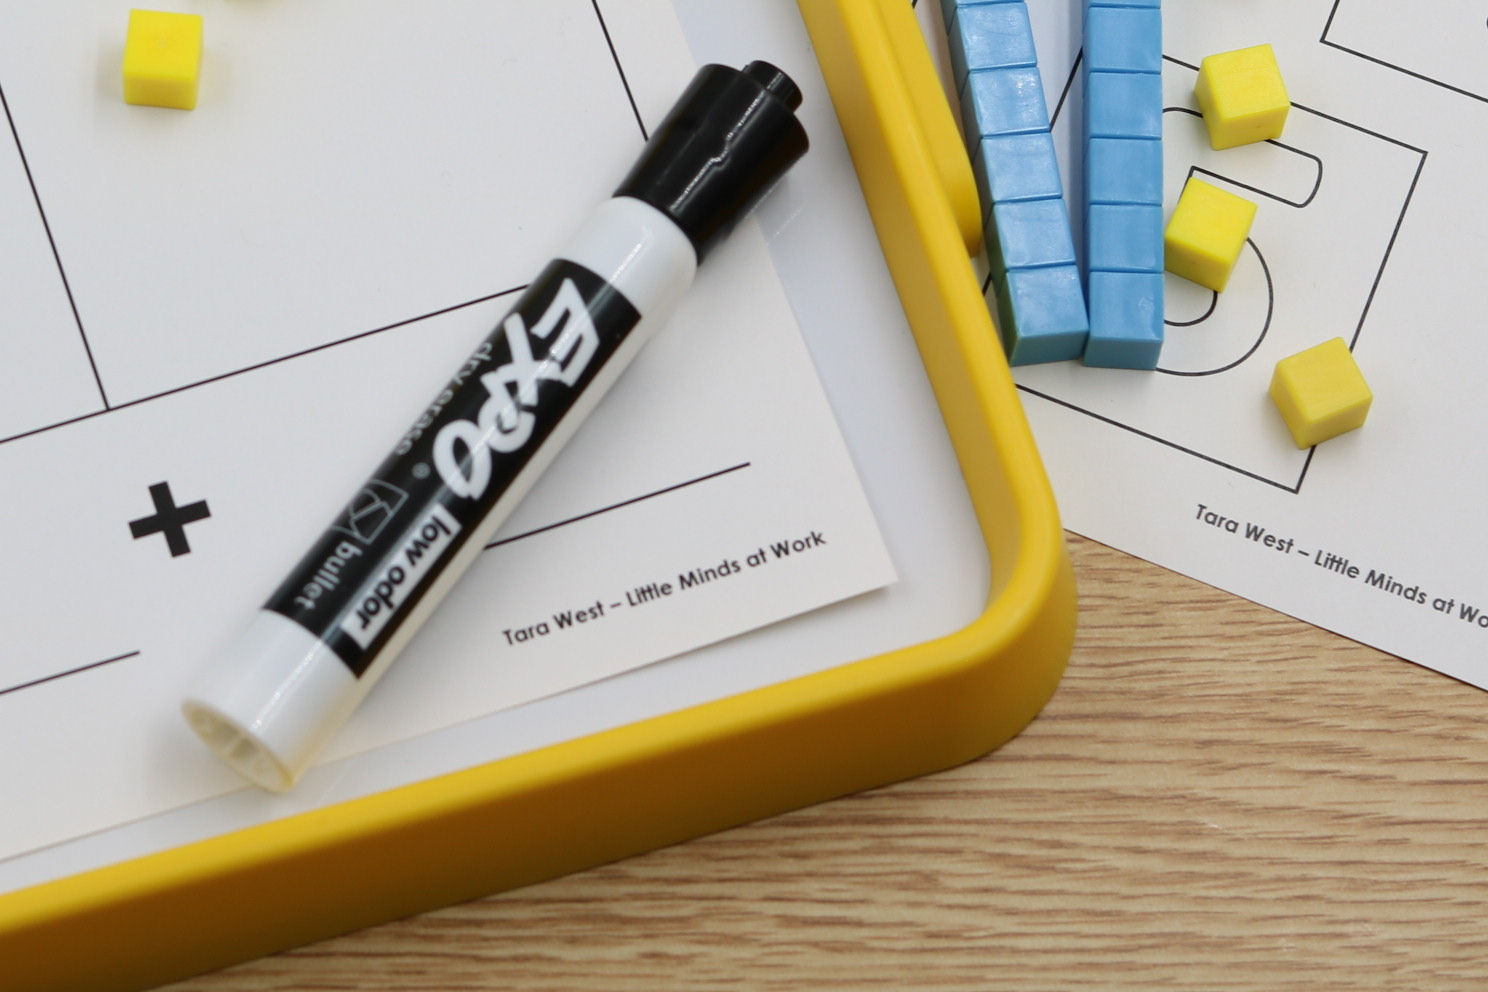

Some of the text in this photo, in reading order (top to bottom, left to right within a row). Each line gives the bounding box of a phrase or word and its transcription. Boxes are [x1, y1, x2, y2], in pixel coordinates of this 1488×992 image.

[394, 341, 493, 456] dry erase
[432, 277, 602, 501] EXPO
[293, 540, 364, 610] bullet
[355, 515, 452, 630] low odor
[502, 621, 551, 646] Tara
[553, 601, 605, 631] West
[625, 580, 673, 608] Little
[678, 558, 742, 591] Minds
[746, 548, 768, 569] at
[770, 530, 827, 560] Work
[1195, 503, 1239, 535] Tara
[1244, 521, 1295, 555] West
[1314, 549, 1360, 579] Little
[1364, 569, 1427, 605] Minds
[1431, 596, 1456, 615] at
